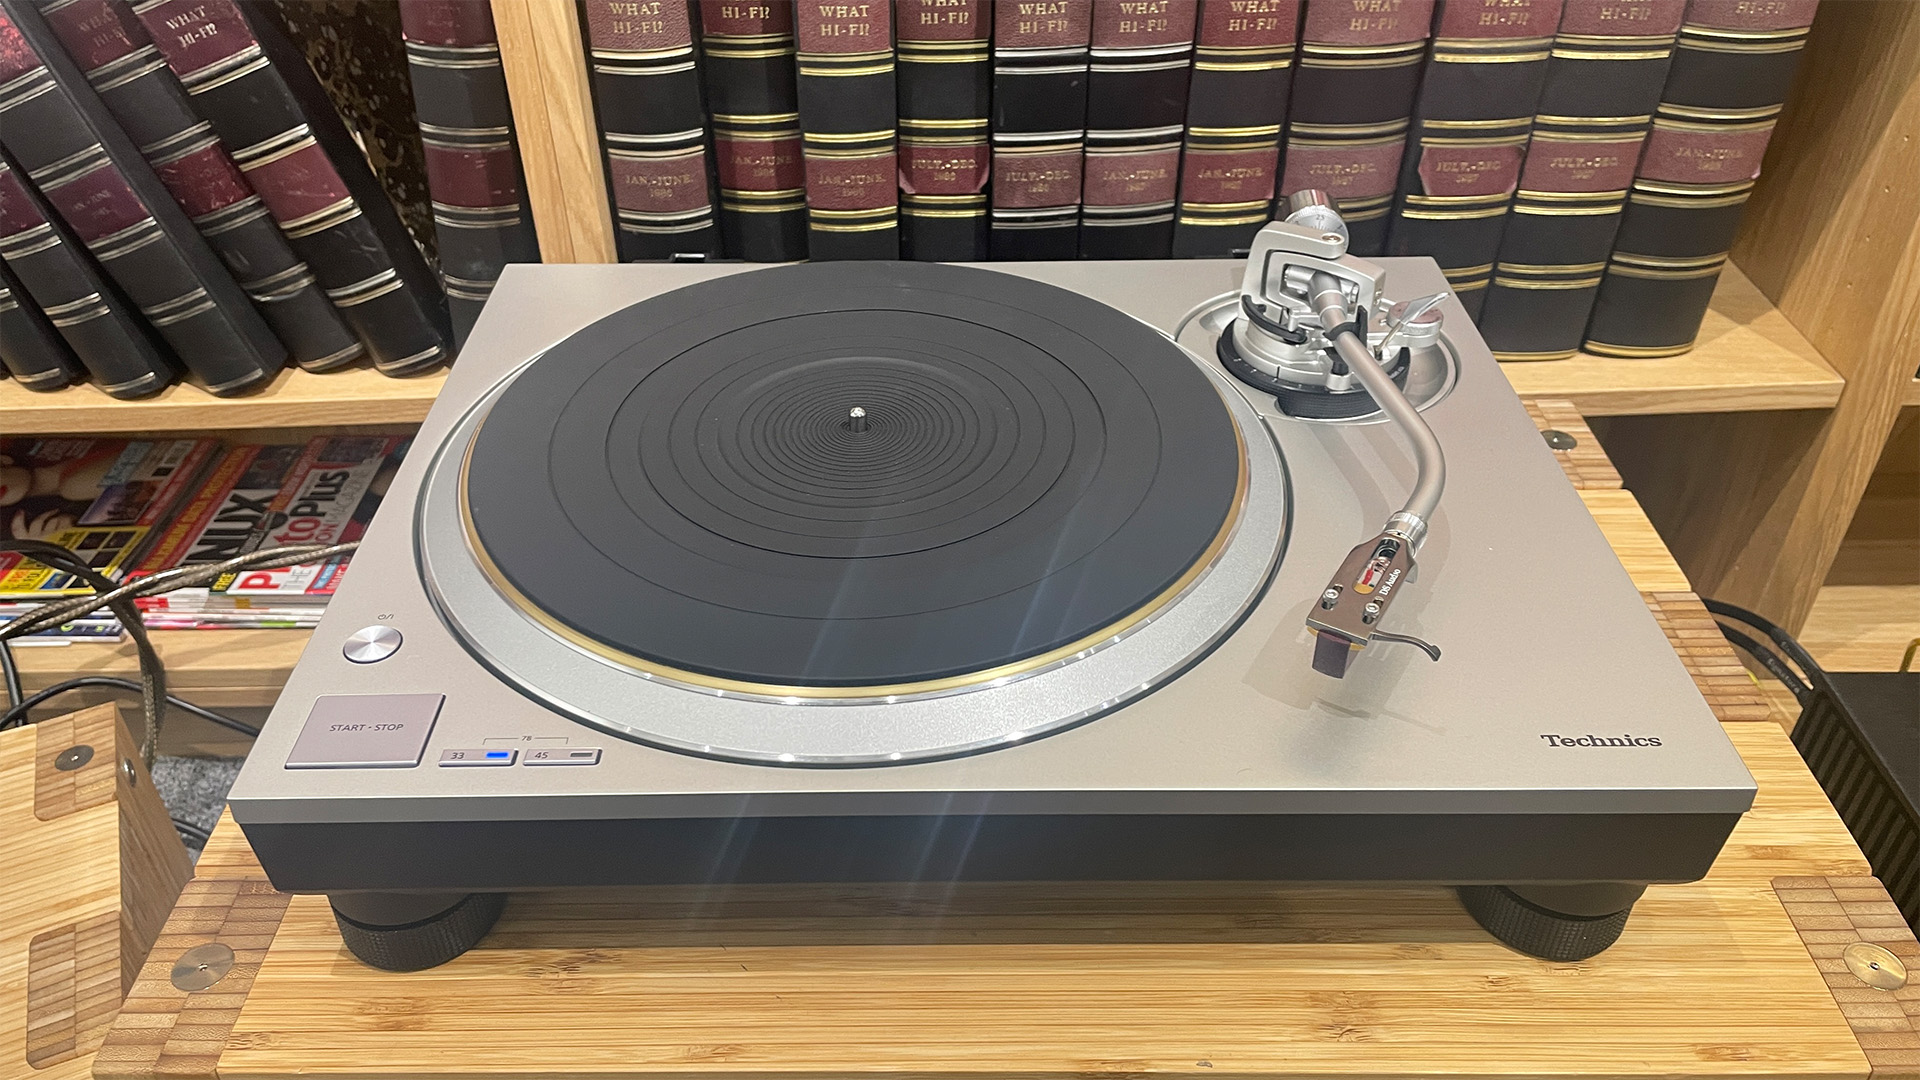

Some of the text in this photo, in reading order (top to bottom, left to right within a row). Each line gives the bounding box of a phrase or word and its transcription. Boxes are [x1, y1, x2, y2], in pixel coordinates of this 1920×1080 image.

[609, 2, 661, 15] WHAT
[721, 6, 770, 19] HI-FI?
[819, 5, 870, 18] WHAT
[1019, 1, 1068, 15] WHAT
[1120, 1, 1168, 14] WHAT
[1231, 0, 1280, 13] WHAT
[1353, 0, 1401, 13] WHAT
[166, 5, 206, 30] WHAT
[920, 12, 969, 25] HI-FI?
[613, 21, 663, 34] HI-FI?
[821, 24, 870, 36] HI-FI?
[176, 493, 280, 566] NUX
[283, 565, 313, 590] THE
[1379, 584, 1391, 596] DS
[329, 723, 404, 732] START STOP
[1539, 734, 1663, 747] Technics
[450, 751, 465, 760] 33
[534, 751, 549, 760] 45
